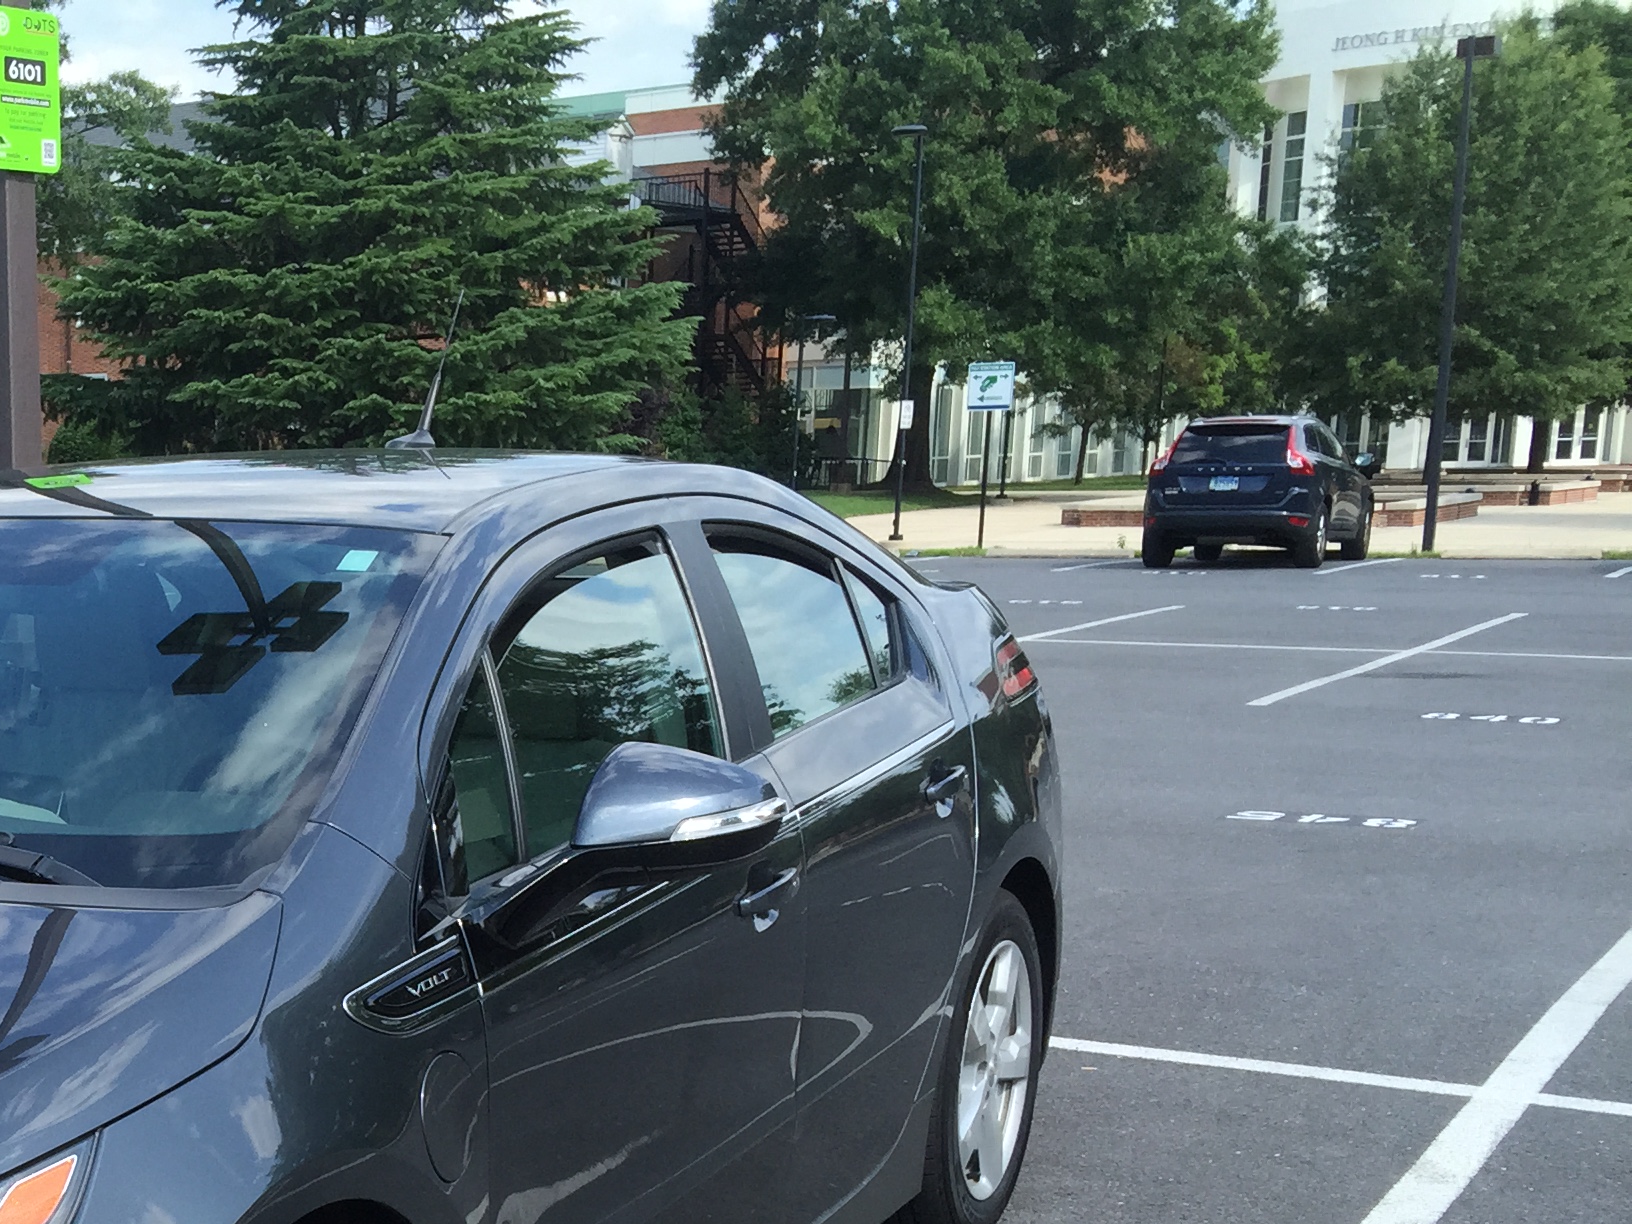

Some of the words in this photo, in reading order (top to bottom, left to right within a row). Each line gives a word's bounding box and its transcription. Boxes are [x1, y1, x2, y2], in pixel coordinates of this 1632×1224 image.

[1332, 31, 1388, 51] JEONG
[1394, 28, 1406, 43] H
[9, 59, 42, 82] 6101
[405, 967, 452, 998] VOLT
